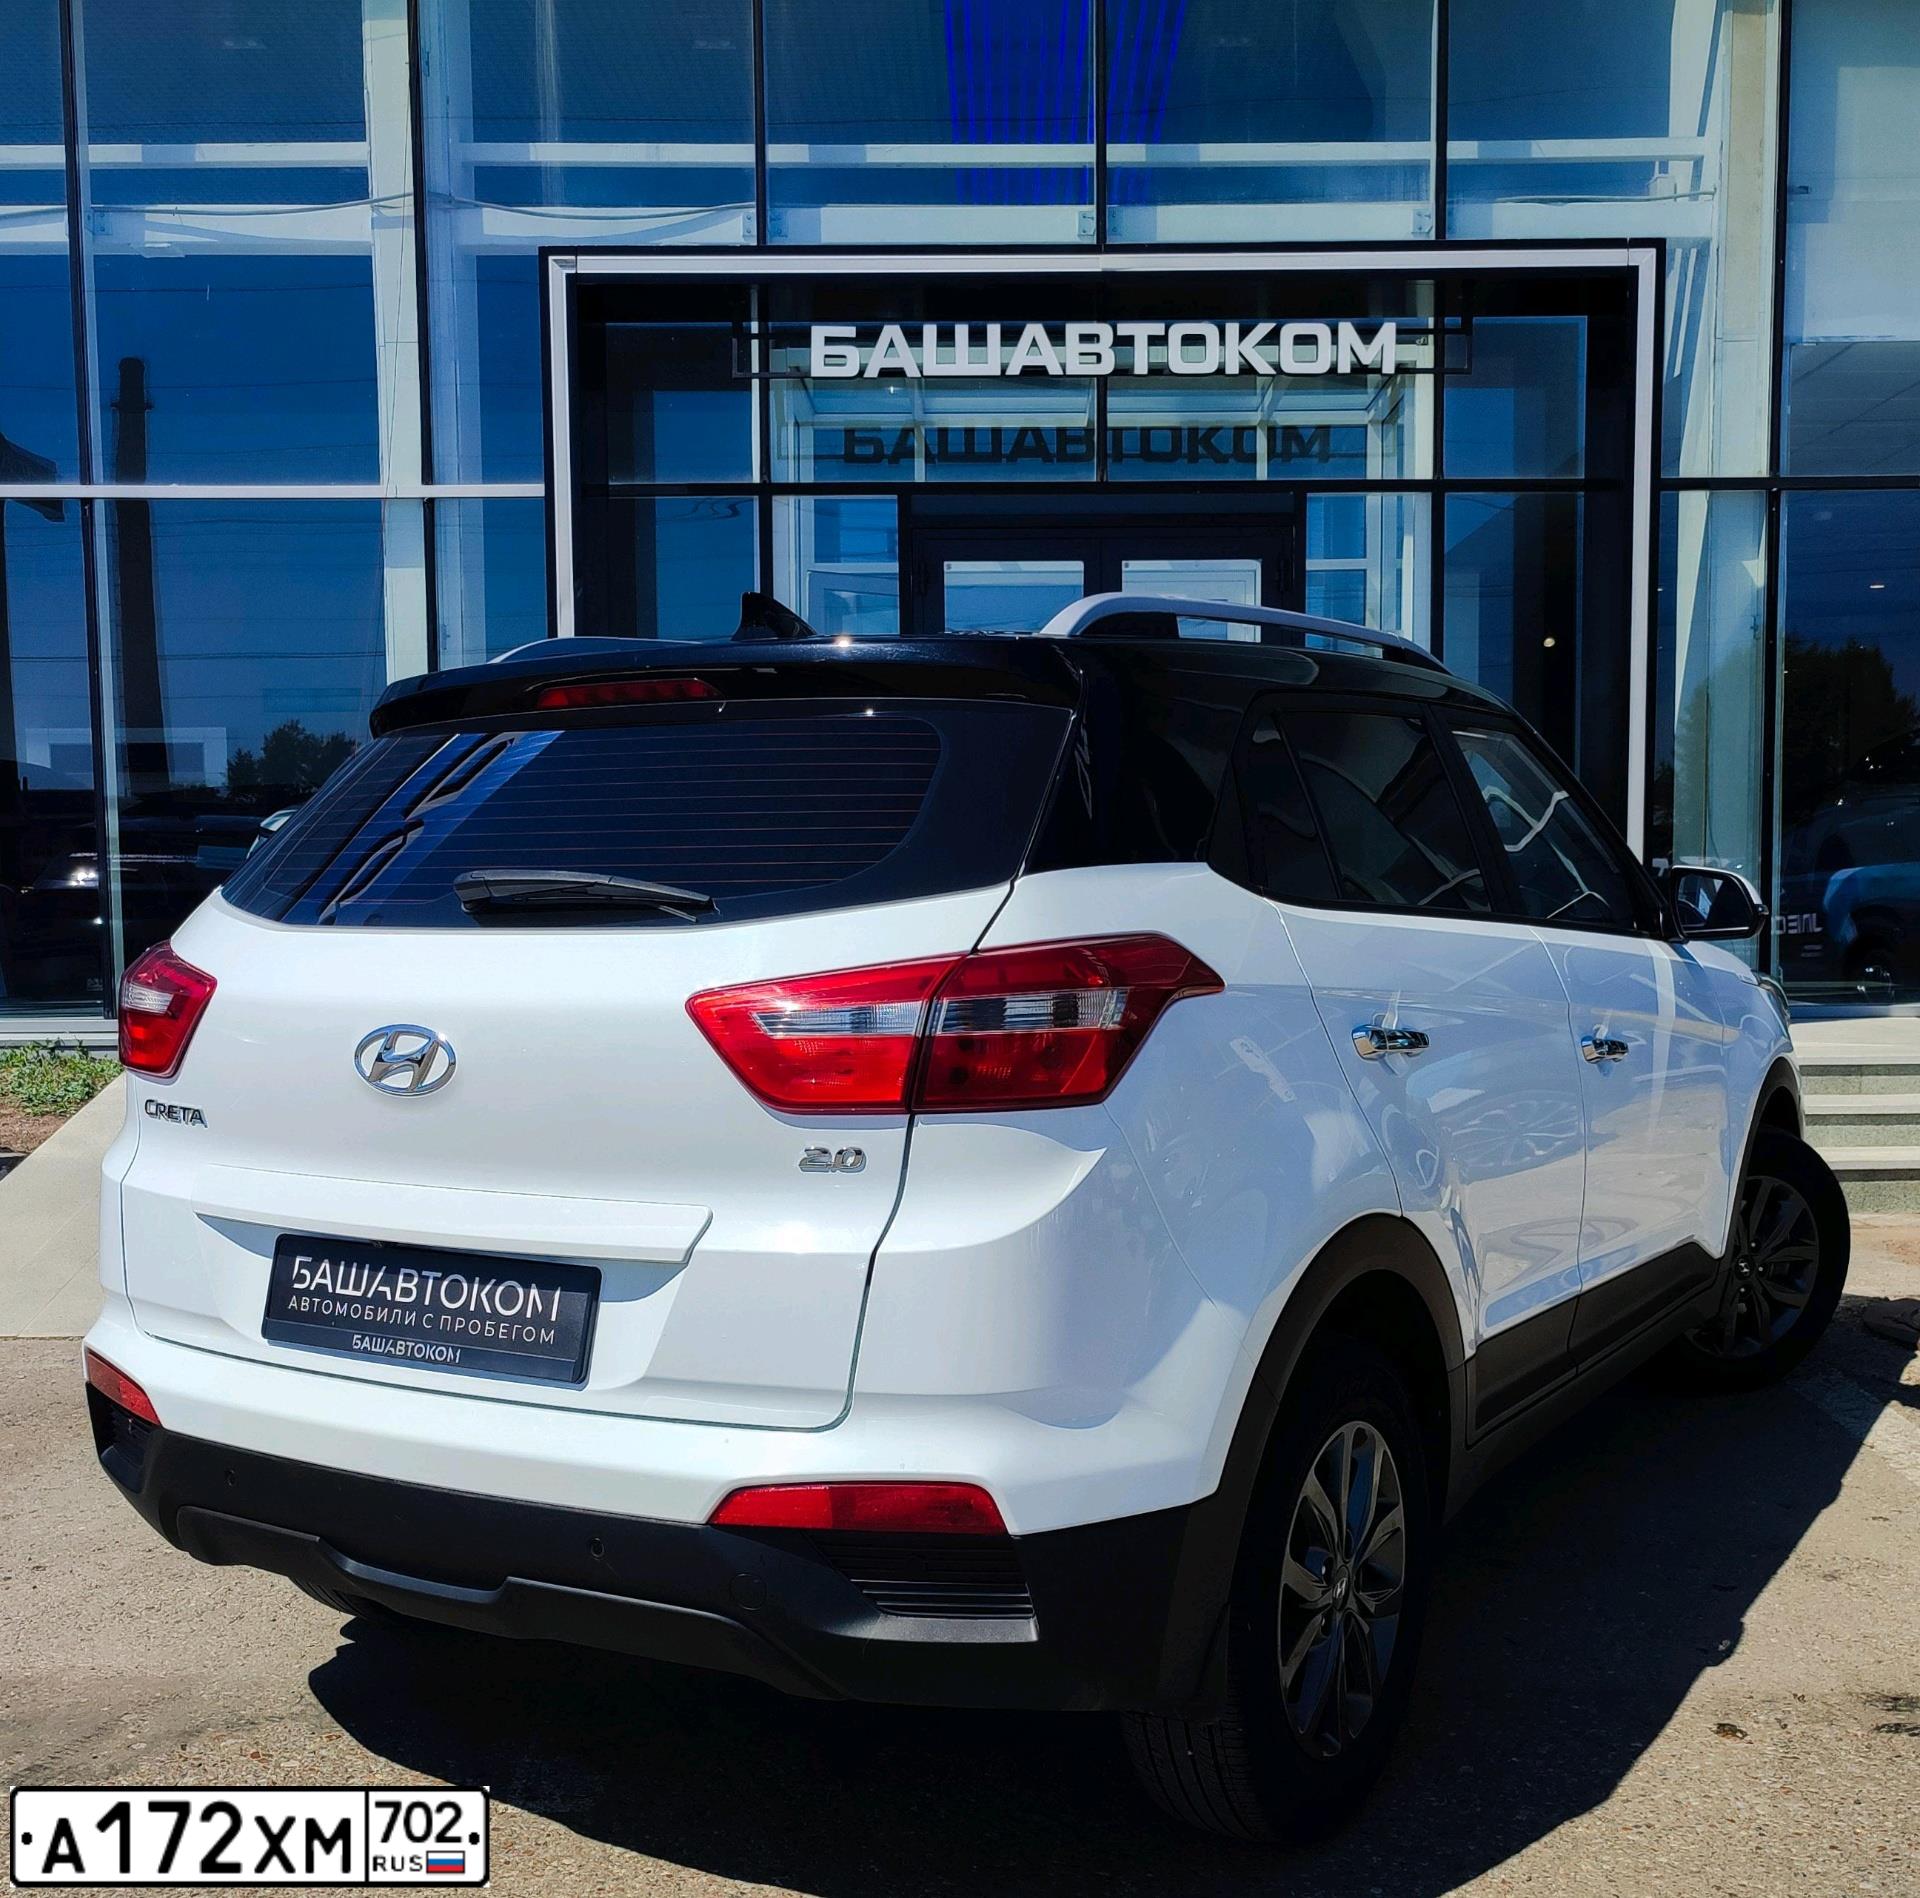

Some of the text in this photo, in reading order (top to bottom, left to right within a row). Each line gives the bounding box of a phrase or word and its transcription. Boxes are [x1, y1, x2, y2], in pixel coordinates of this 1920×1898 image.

[810, 322, 1397, 377] БАШАВТОКОМ
[144, 1098, 209, 1129] CRETA
[798, 1146, 867, 1173] 2.0
[291, 1255, 562, 1322] БАШАВТОКОМ
[288, 1295, 556, 1345] АВТОМОБИЛИ С ПРОБЕГОМ
[352, 1334, 461, 1364] БАШАВТОКОМ
